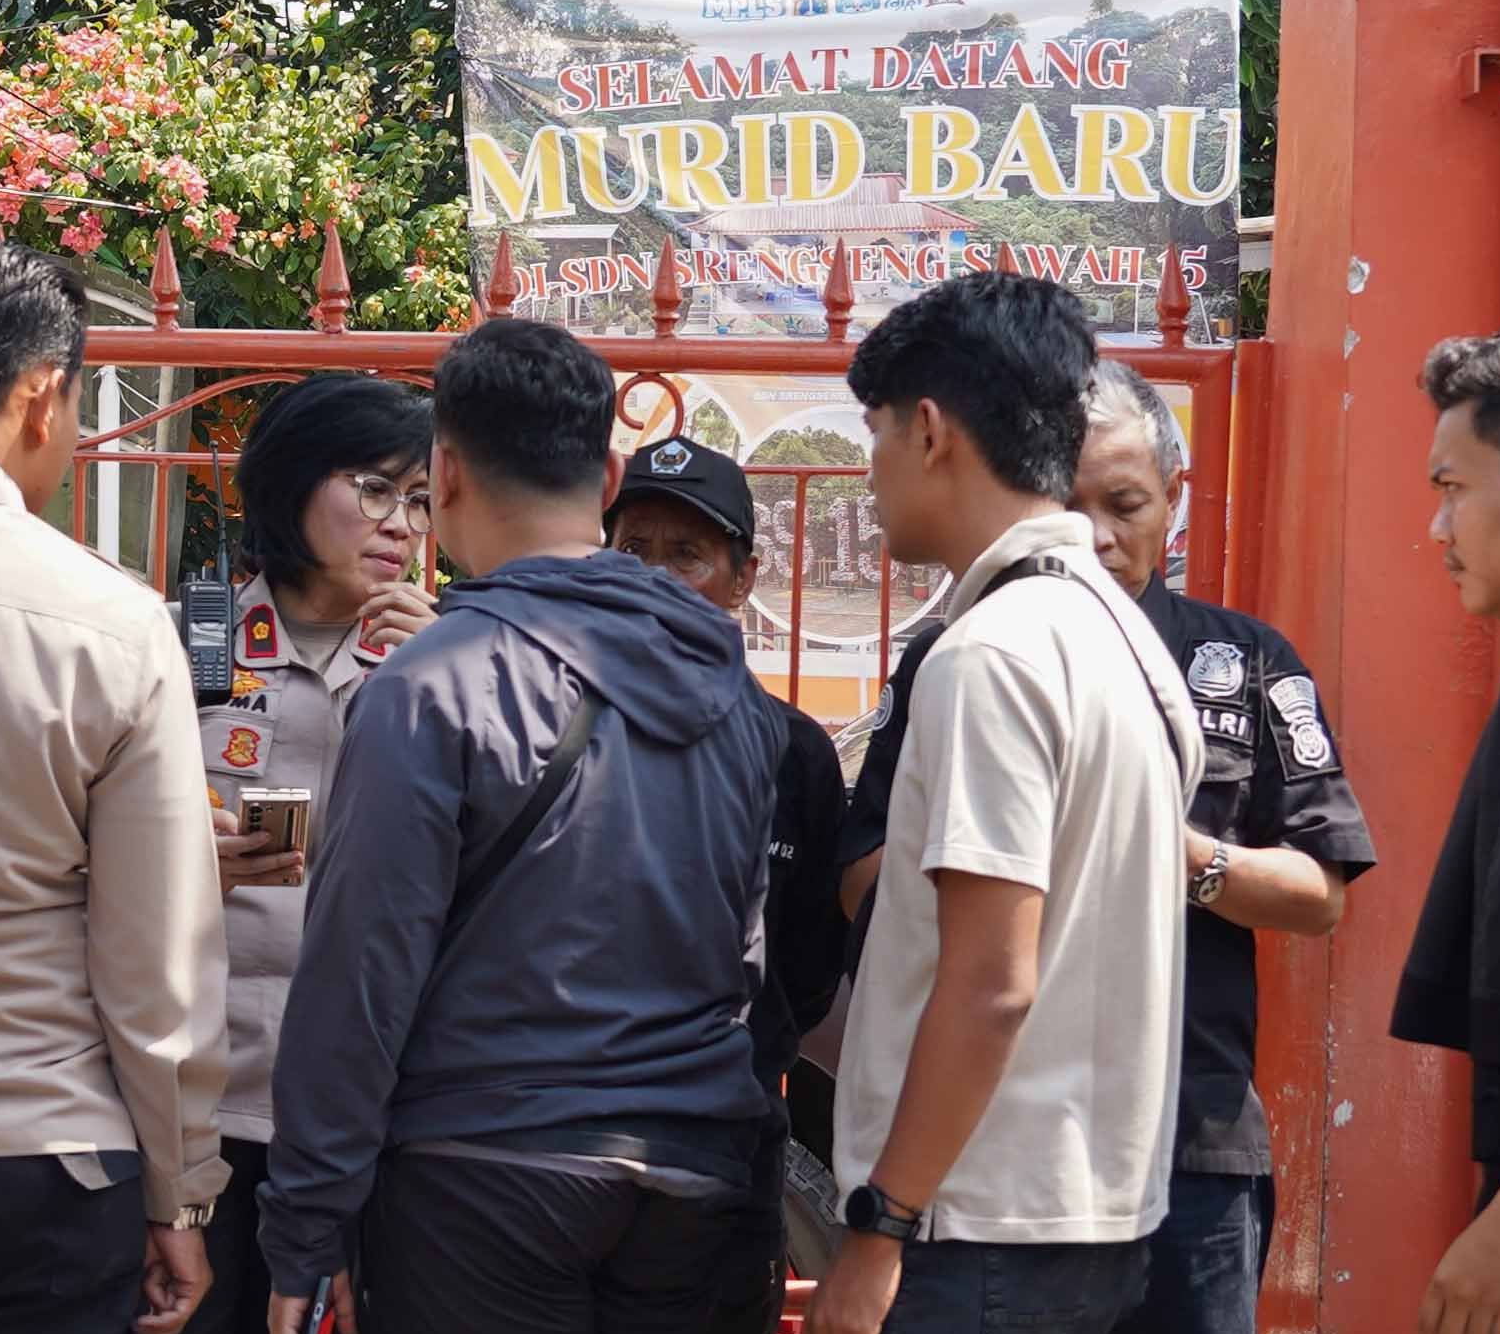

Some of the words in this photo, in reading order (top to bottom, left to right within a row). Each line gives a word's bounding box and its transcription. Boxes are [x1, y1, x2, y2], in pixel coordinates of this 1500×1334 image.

[558, 45, 850, 115] SELAMAT
[867, 37, 1132, 93] DATANG
[465, 108, 866, 228] MURID
[900, 103, 1241, 205] BARU
[559, 251, 654, 298] SDN
[1202, 707, 1248, 737] LRI
